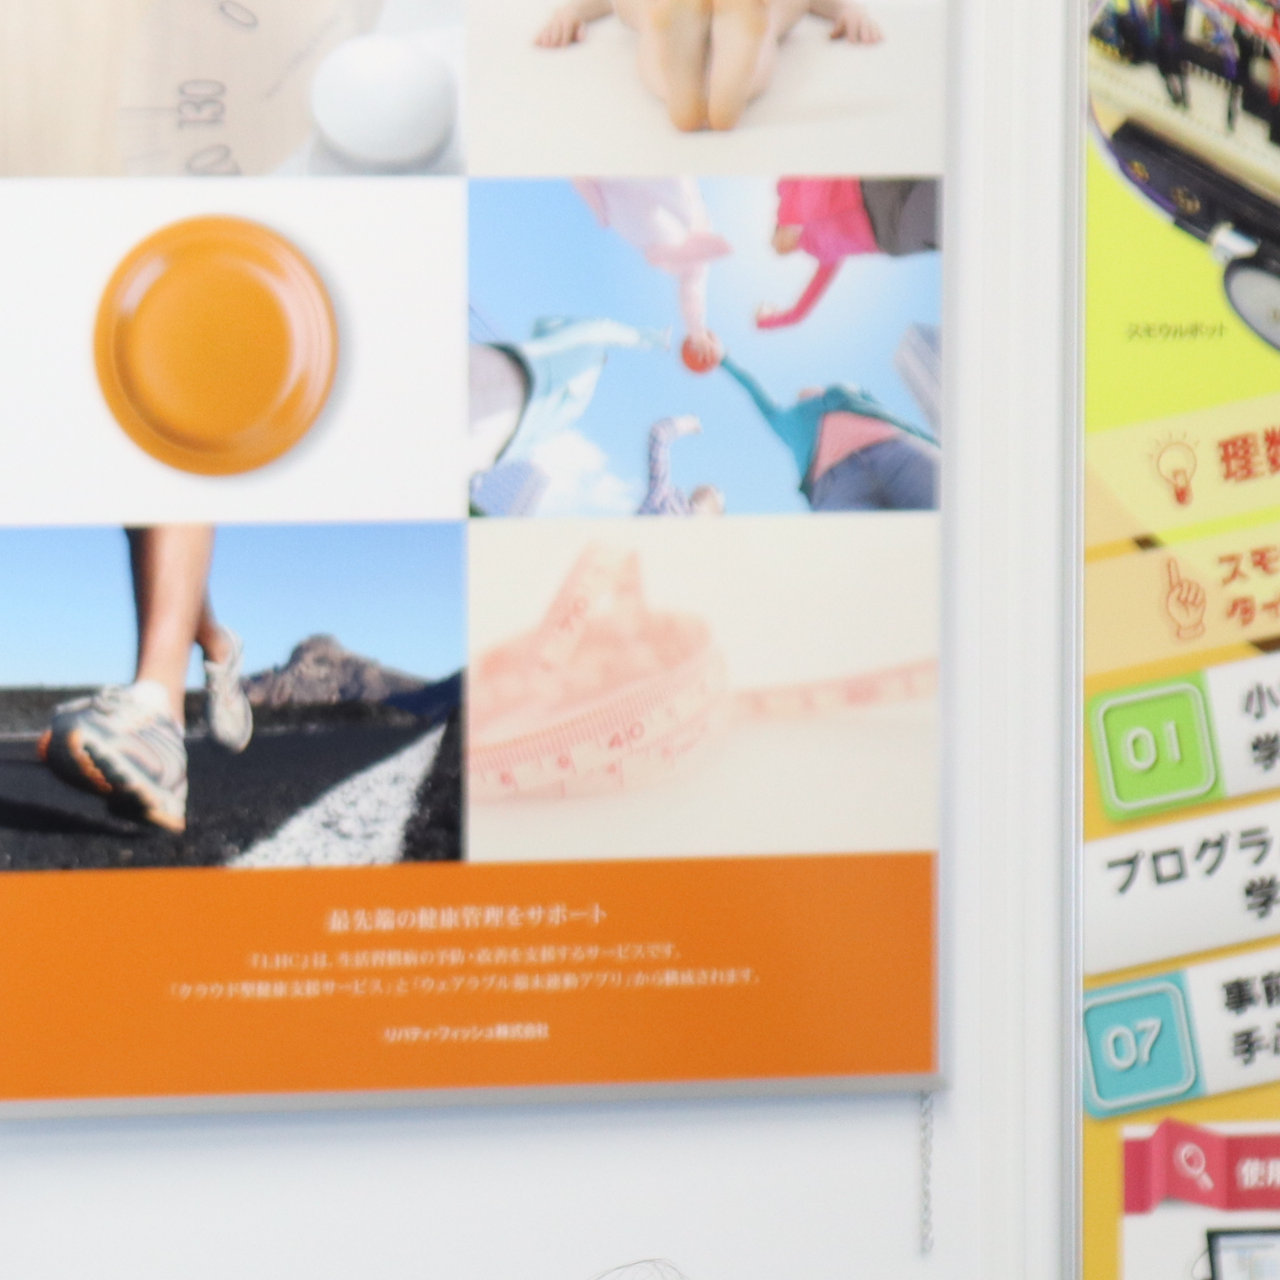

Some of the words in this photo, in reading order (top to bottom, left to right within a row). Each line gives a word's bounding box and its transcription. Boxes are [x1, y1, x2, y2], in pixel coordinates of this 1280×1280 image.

[1123, 720, 1182, 771] 01
[1107, 826, 1273, 893] プログラ
[1104, 1017, 1163, 1071] 07
